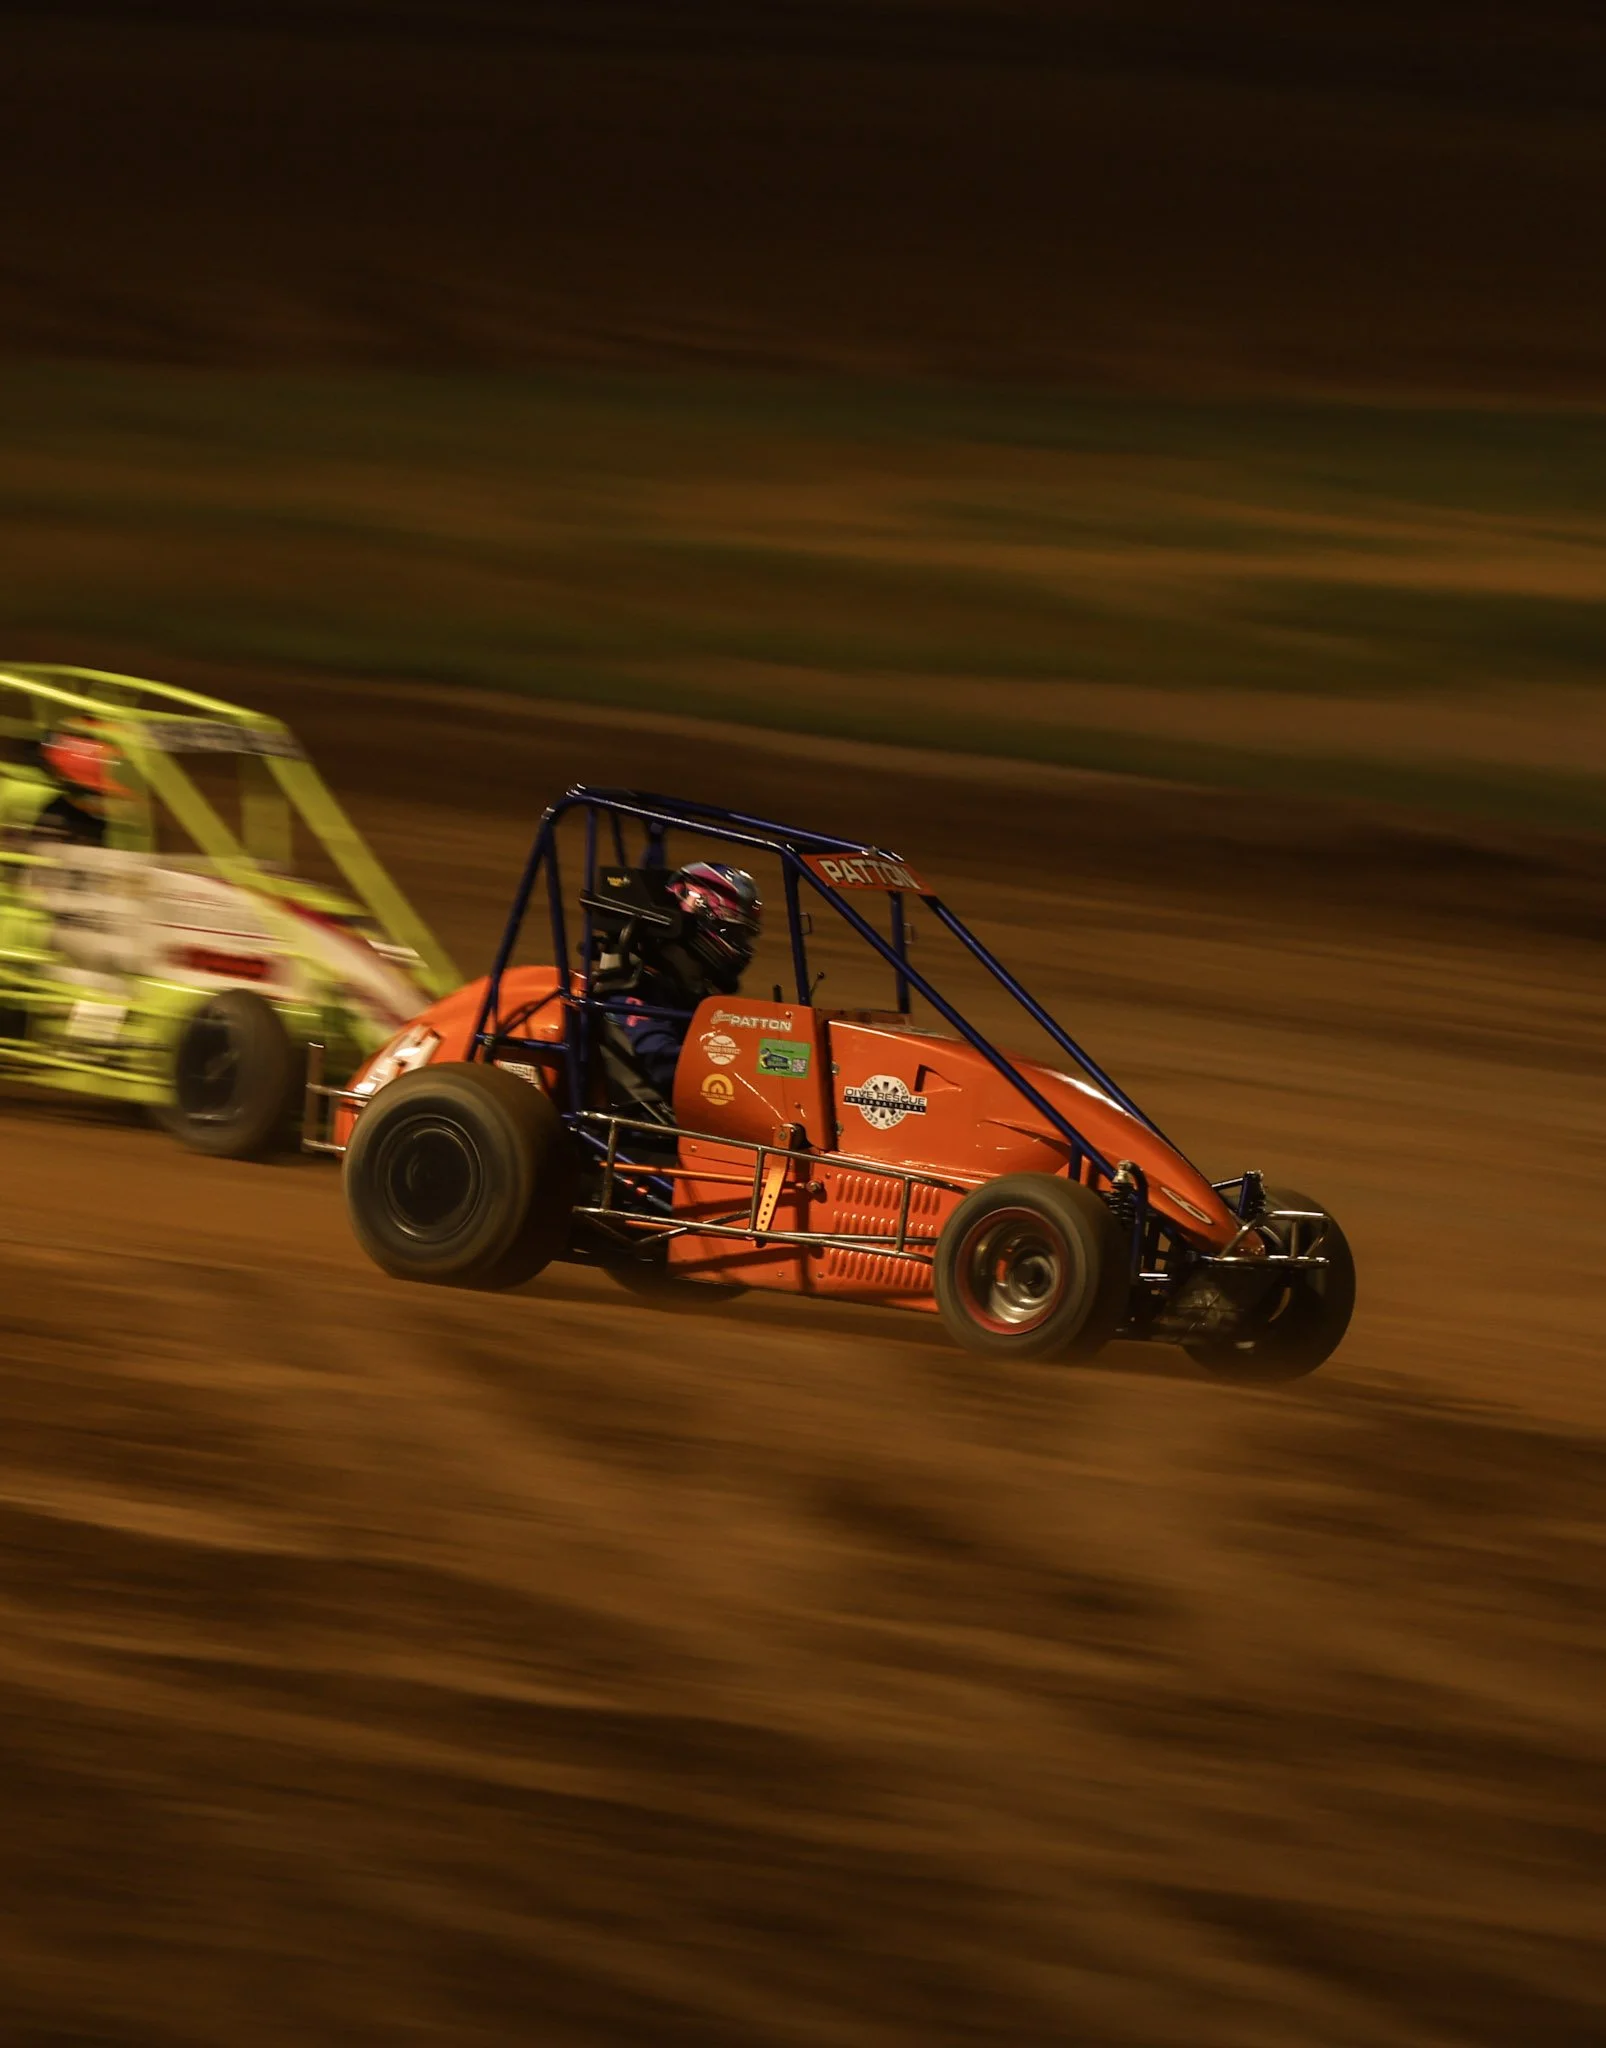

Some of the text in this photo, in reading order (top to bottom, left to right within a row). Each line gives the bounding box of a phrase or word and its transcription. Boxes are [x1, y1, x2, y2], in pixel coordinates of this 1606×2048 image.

[818, 858, 921, 890] PATTON
[730, 1015, 792, 1032] PATTON
[845, 1088, 926, 1106] DIVE RESCUE
